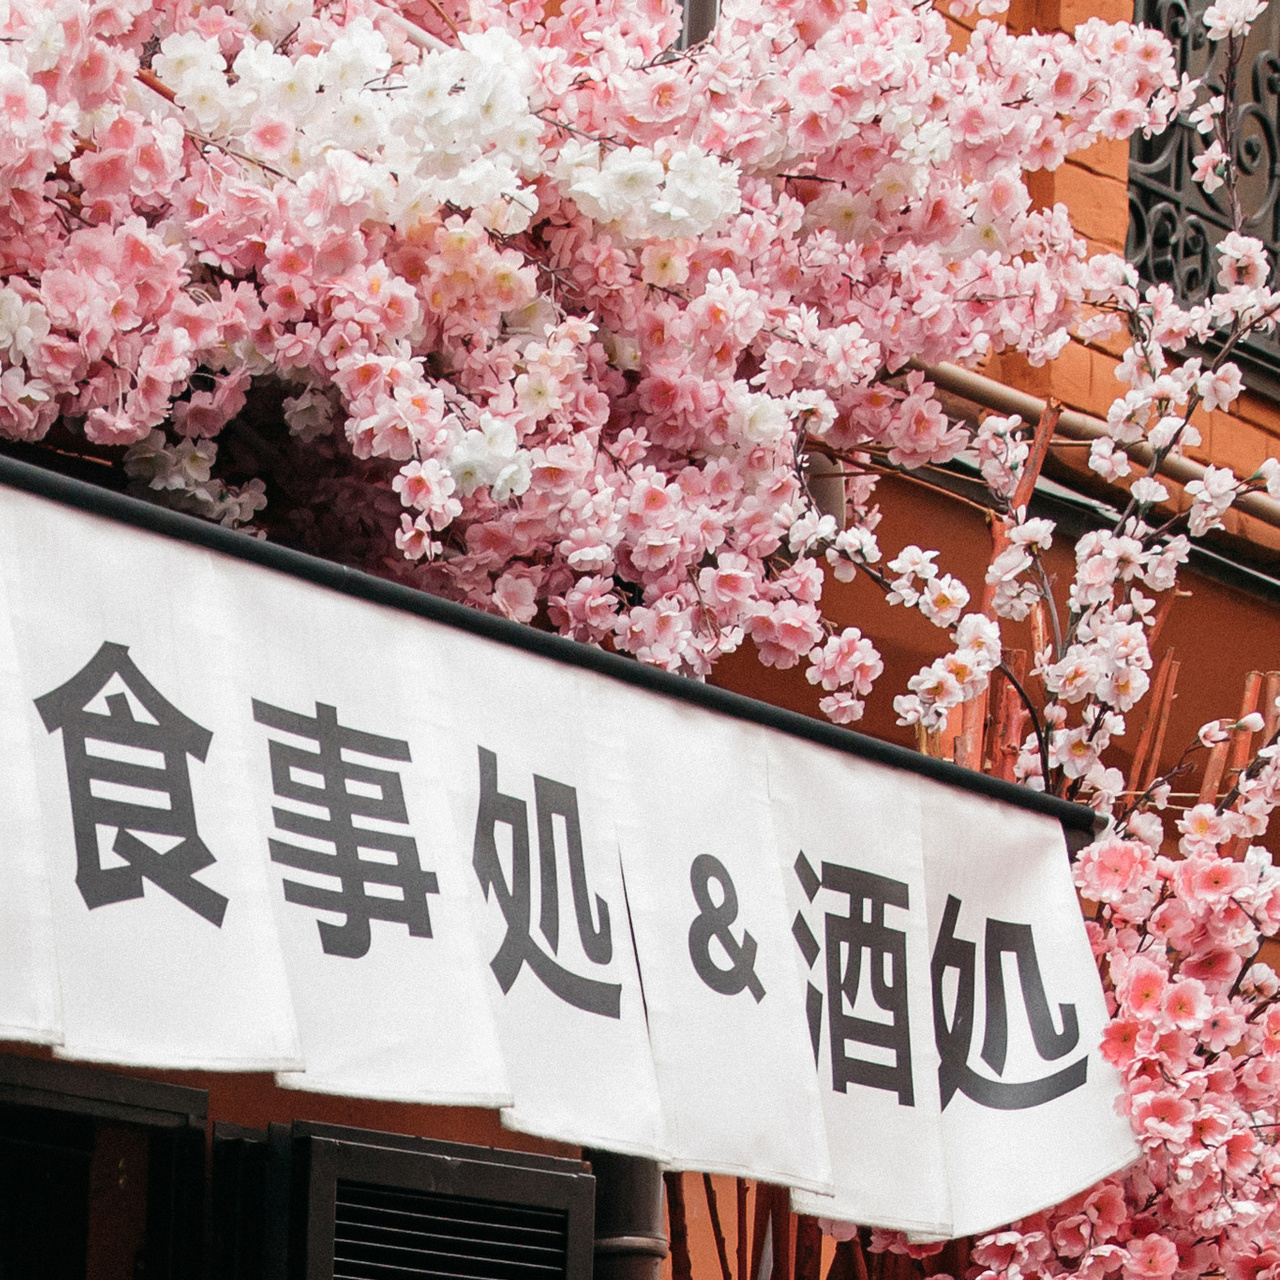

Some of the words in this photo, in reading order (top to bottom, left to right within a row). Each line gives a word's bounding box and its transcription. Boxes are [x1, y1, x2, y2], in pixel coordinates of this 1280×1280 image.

[34, 641, 622, 1019] 食事処
[688, 854, 766, 1004] &
[791, 849, 1089, 1113] 酒処
